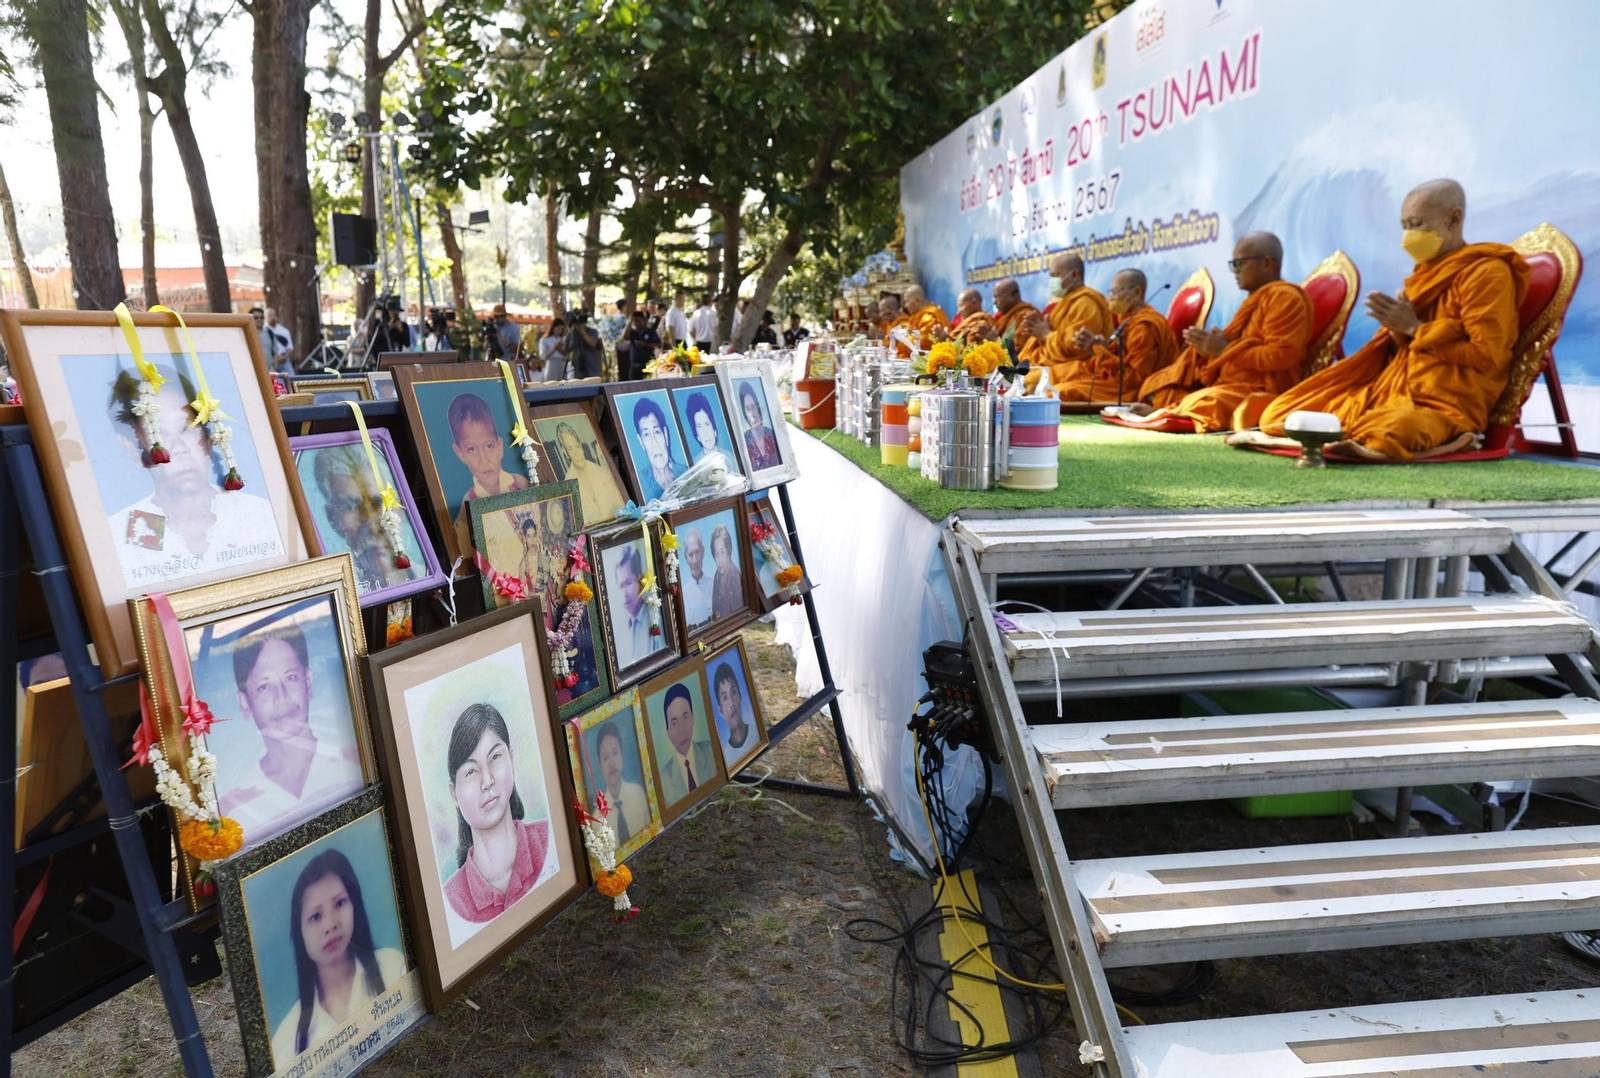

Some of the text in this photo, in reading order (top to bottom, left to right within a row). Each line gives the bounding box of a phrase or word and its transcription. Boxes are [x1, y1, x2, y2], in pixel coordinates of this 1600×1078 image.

[987, 163, 1004, 201] 20
[1116, 32, 1261, 144] TSUNAMI
[1075, 172, 1120, 219] 2567
[1152, 209, 1219, 253] จังหวัดพังงา
[281, 1054, 314, 1078] างสาว
